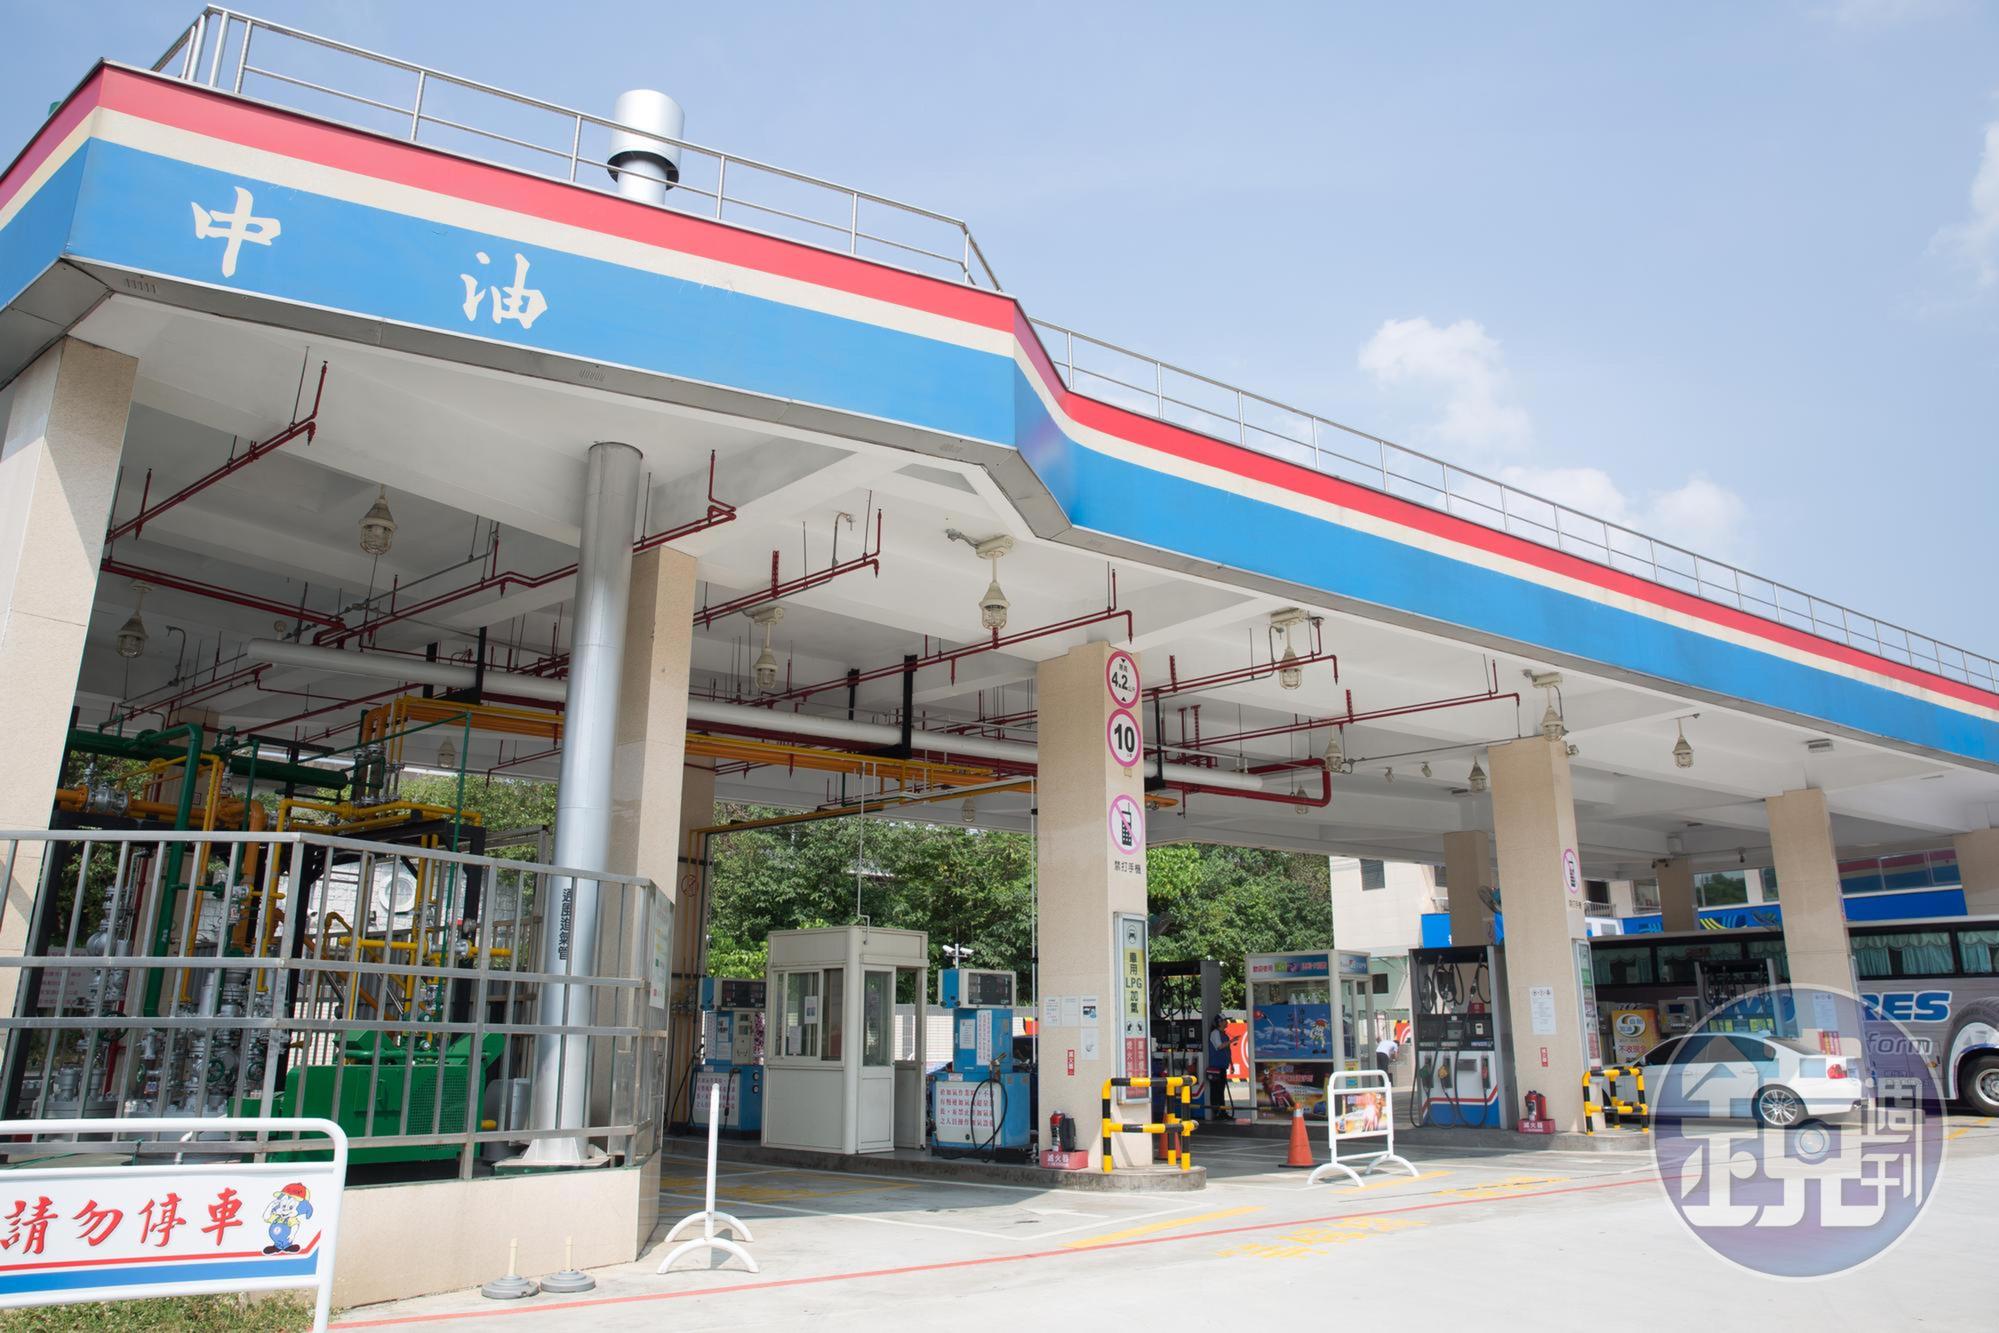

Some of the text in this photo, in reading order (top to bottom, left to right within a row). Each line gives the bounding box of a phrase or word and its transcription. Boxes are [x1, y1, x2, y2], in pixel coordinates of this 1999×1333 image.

[191, 186, 548, 329] 中油
[1111, 671, 1128, 691] 4.2
[1114, 723, 1135, 752] 10
[1126, 977, 1142, 989] LPG
[0, 1187, 244, 1255] 請勿停車
